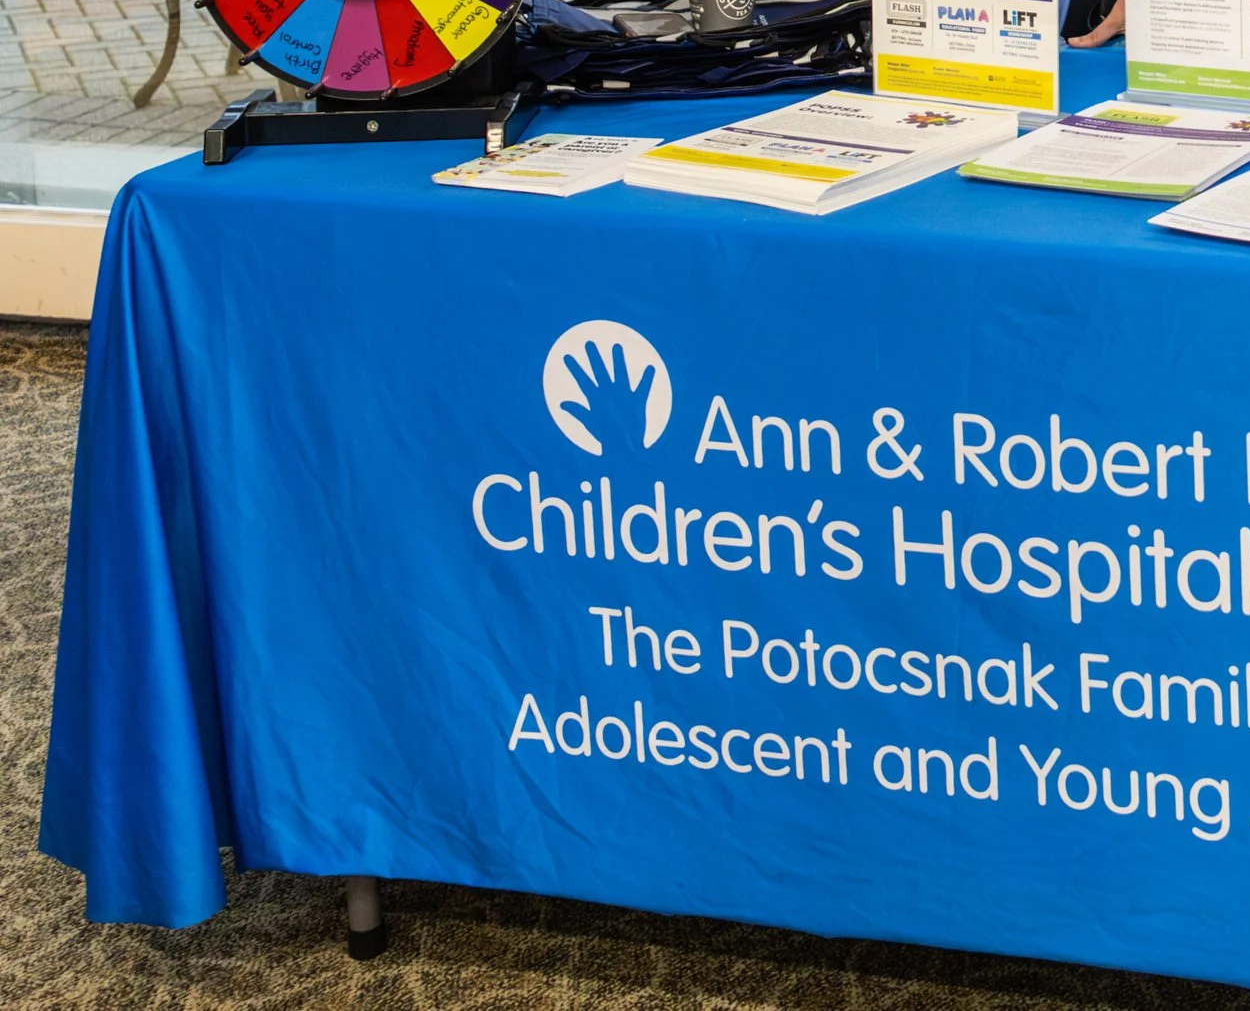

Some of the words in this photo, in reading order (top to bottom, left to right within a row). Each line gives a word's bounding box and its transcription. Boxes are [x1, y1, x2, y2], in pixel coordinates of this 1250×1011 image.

[452, 5, 490, 40] Gender
[736, 9, 748, 17] TEA
[892, 2, 922, 14] FLASH
[938, 6, 976, 22] PLAN
[978, 9, 990, 23] A
[284, 52, 323, 76] Birth
[341, 48, 384, 81] Hygiene
[695, 396, 840, 474] Ann
[867, 408, 923, 480] &
[954, 413, 1210, 501] Robert
[589, 607, 700, 673] The
[723, 621, 1058, 710] Potocsnak
[509, 694, 851, 784] Adolescent
[874, 737, 998, 800] and
[1020, 745, 1229, 840] Young
